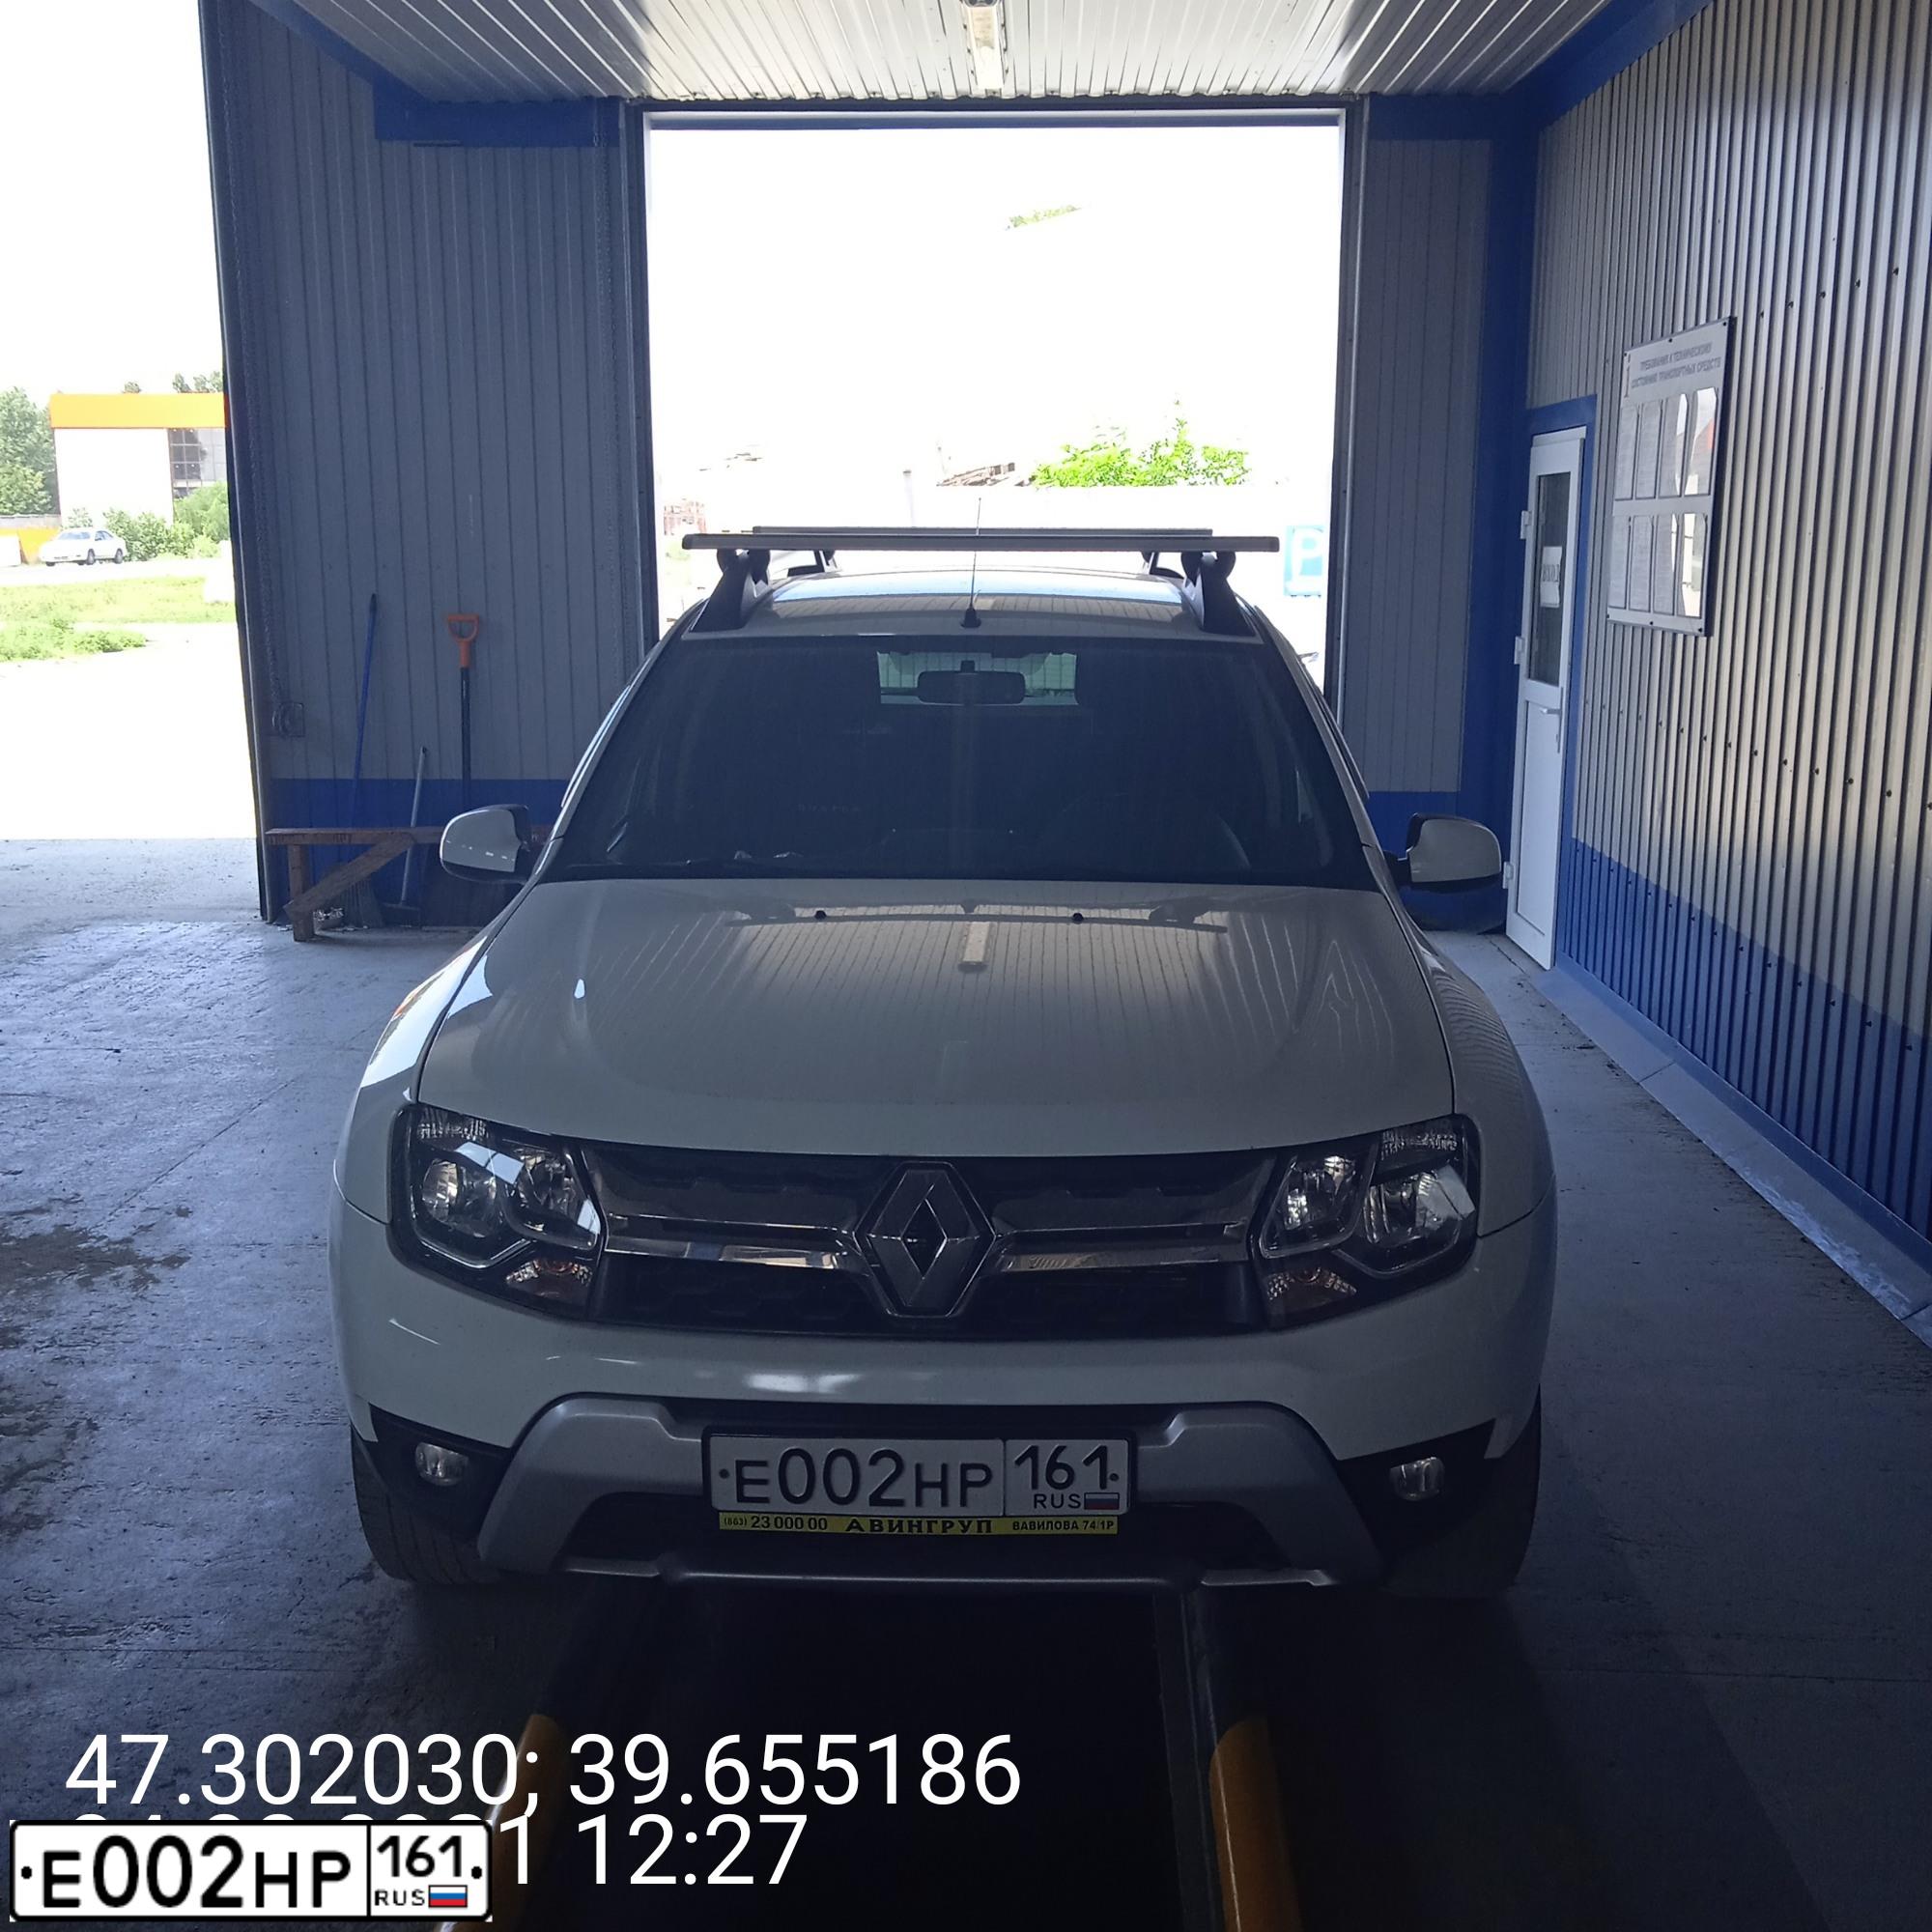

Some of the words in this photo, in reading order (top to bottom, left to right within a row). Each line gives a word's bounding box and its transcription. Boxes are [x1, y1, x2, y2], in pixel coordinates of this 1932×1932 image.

[1014, 1444, 1109, 1491] 161
[1034, 1493, 1081, 1510] RUS
[751, 1515, 770, 1529] 23
[774, 1516, 804, 1530] 000
[808, 1517, 828, 1531] 00
[845, 1518, 992, 1534] АВИНГРУП
[1012, 1520, 1079, 1531] ВАВИЛОВА
